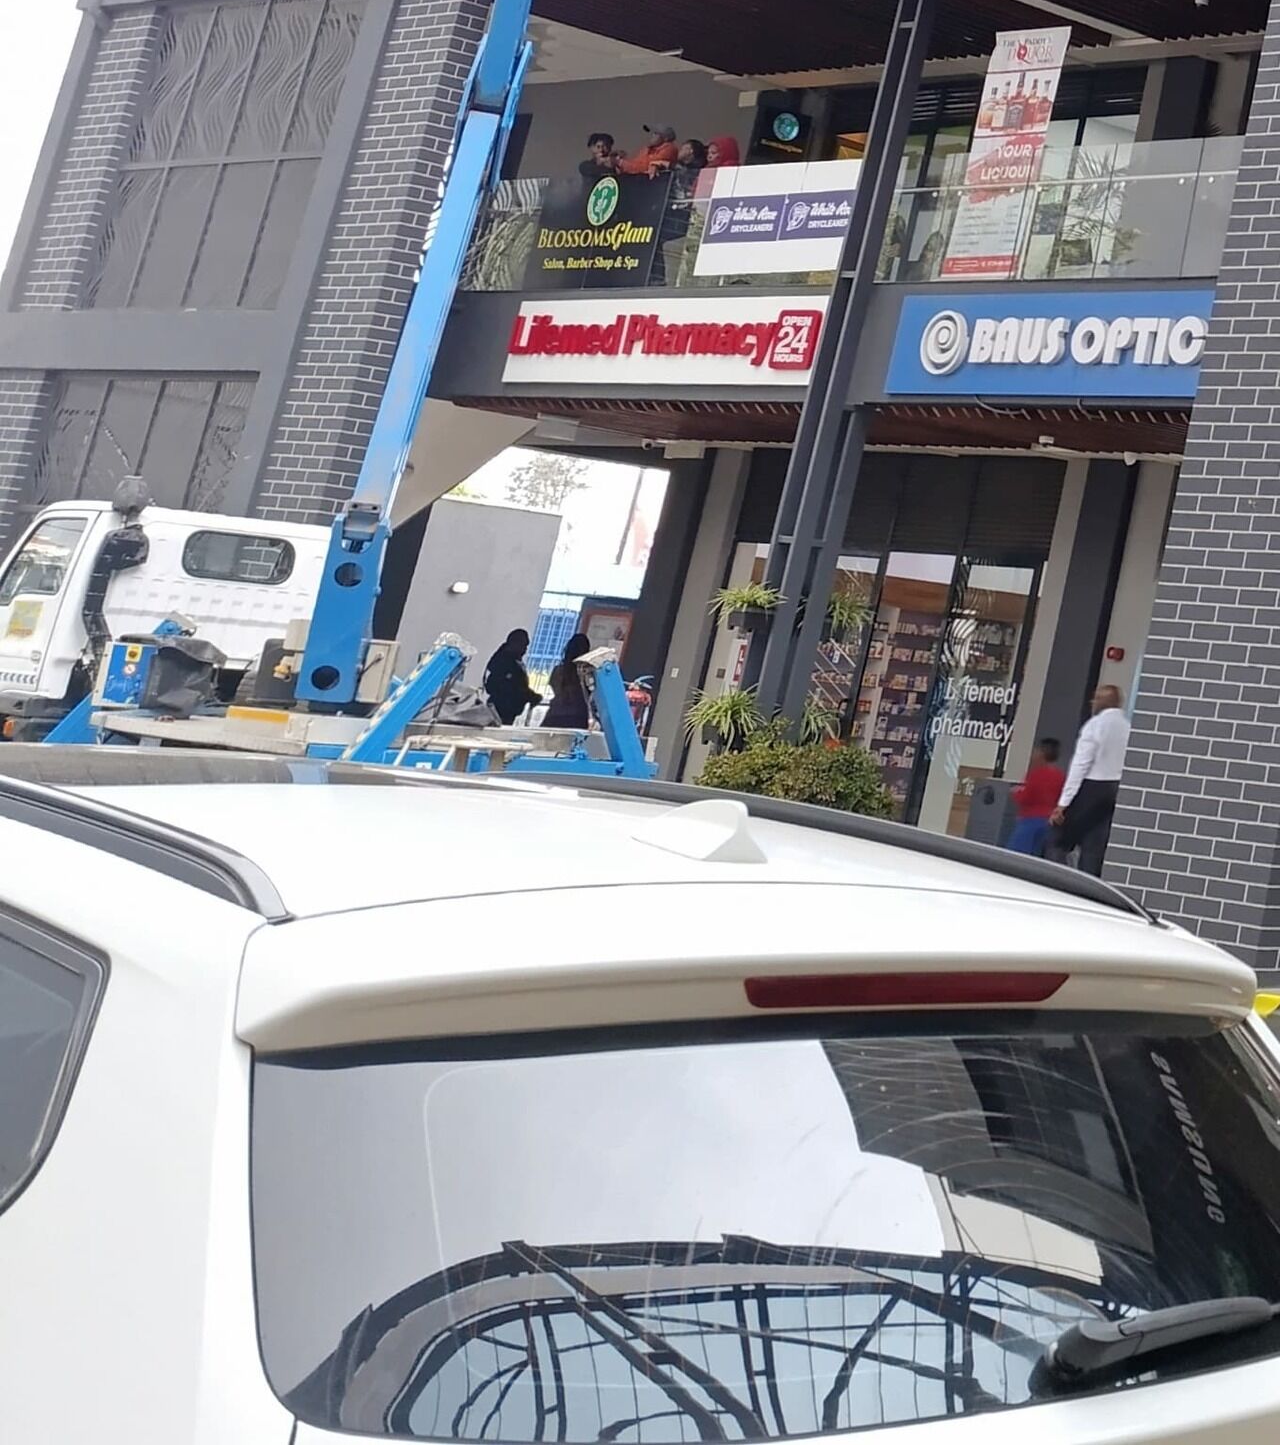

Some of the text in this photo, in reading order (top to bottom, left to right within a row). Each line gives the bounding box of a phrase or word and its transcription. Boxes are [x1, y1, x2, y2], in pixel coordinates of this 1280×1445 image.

[997, 144, 1034, 159] YOUR
[566, 257, 593, 269] Barber
[594, 256, 613, 270] Shop
[614, 256, 622, 268] &
[624, 256, 639, 270] Spa
[781, 315, 812, 327] OPEN
[507, 314, 778, 367] Lifemed Pharmacy
[773, 326, 809, 354] 24
[967, 317, 1071, 365] BAUS
[773, 352, 804, 363] HOURS
[930, 714, 1013, 746] pharmacy
